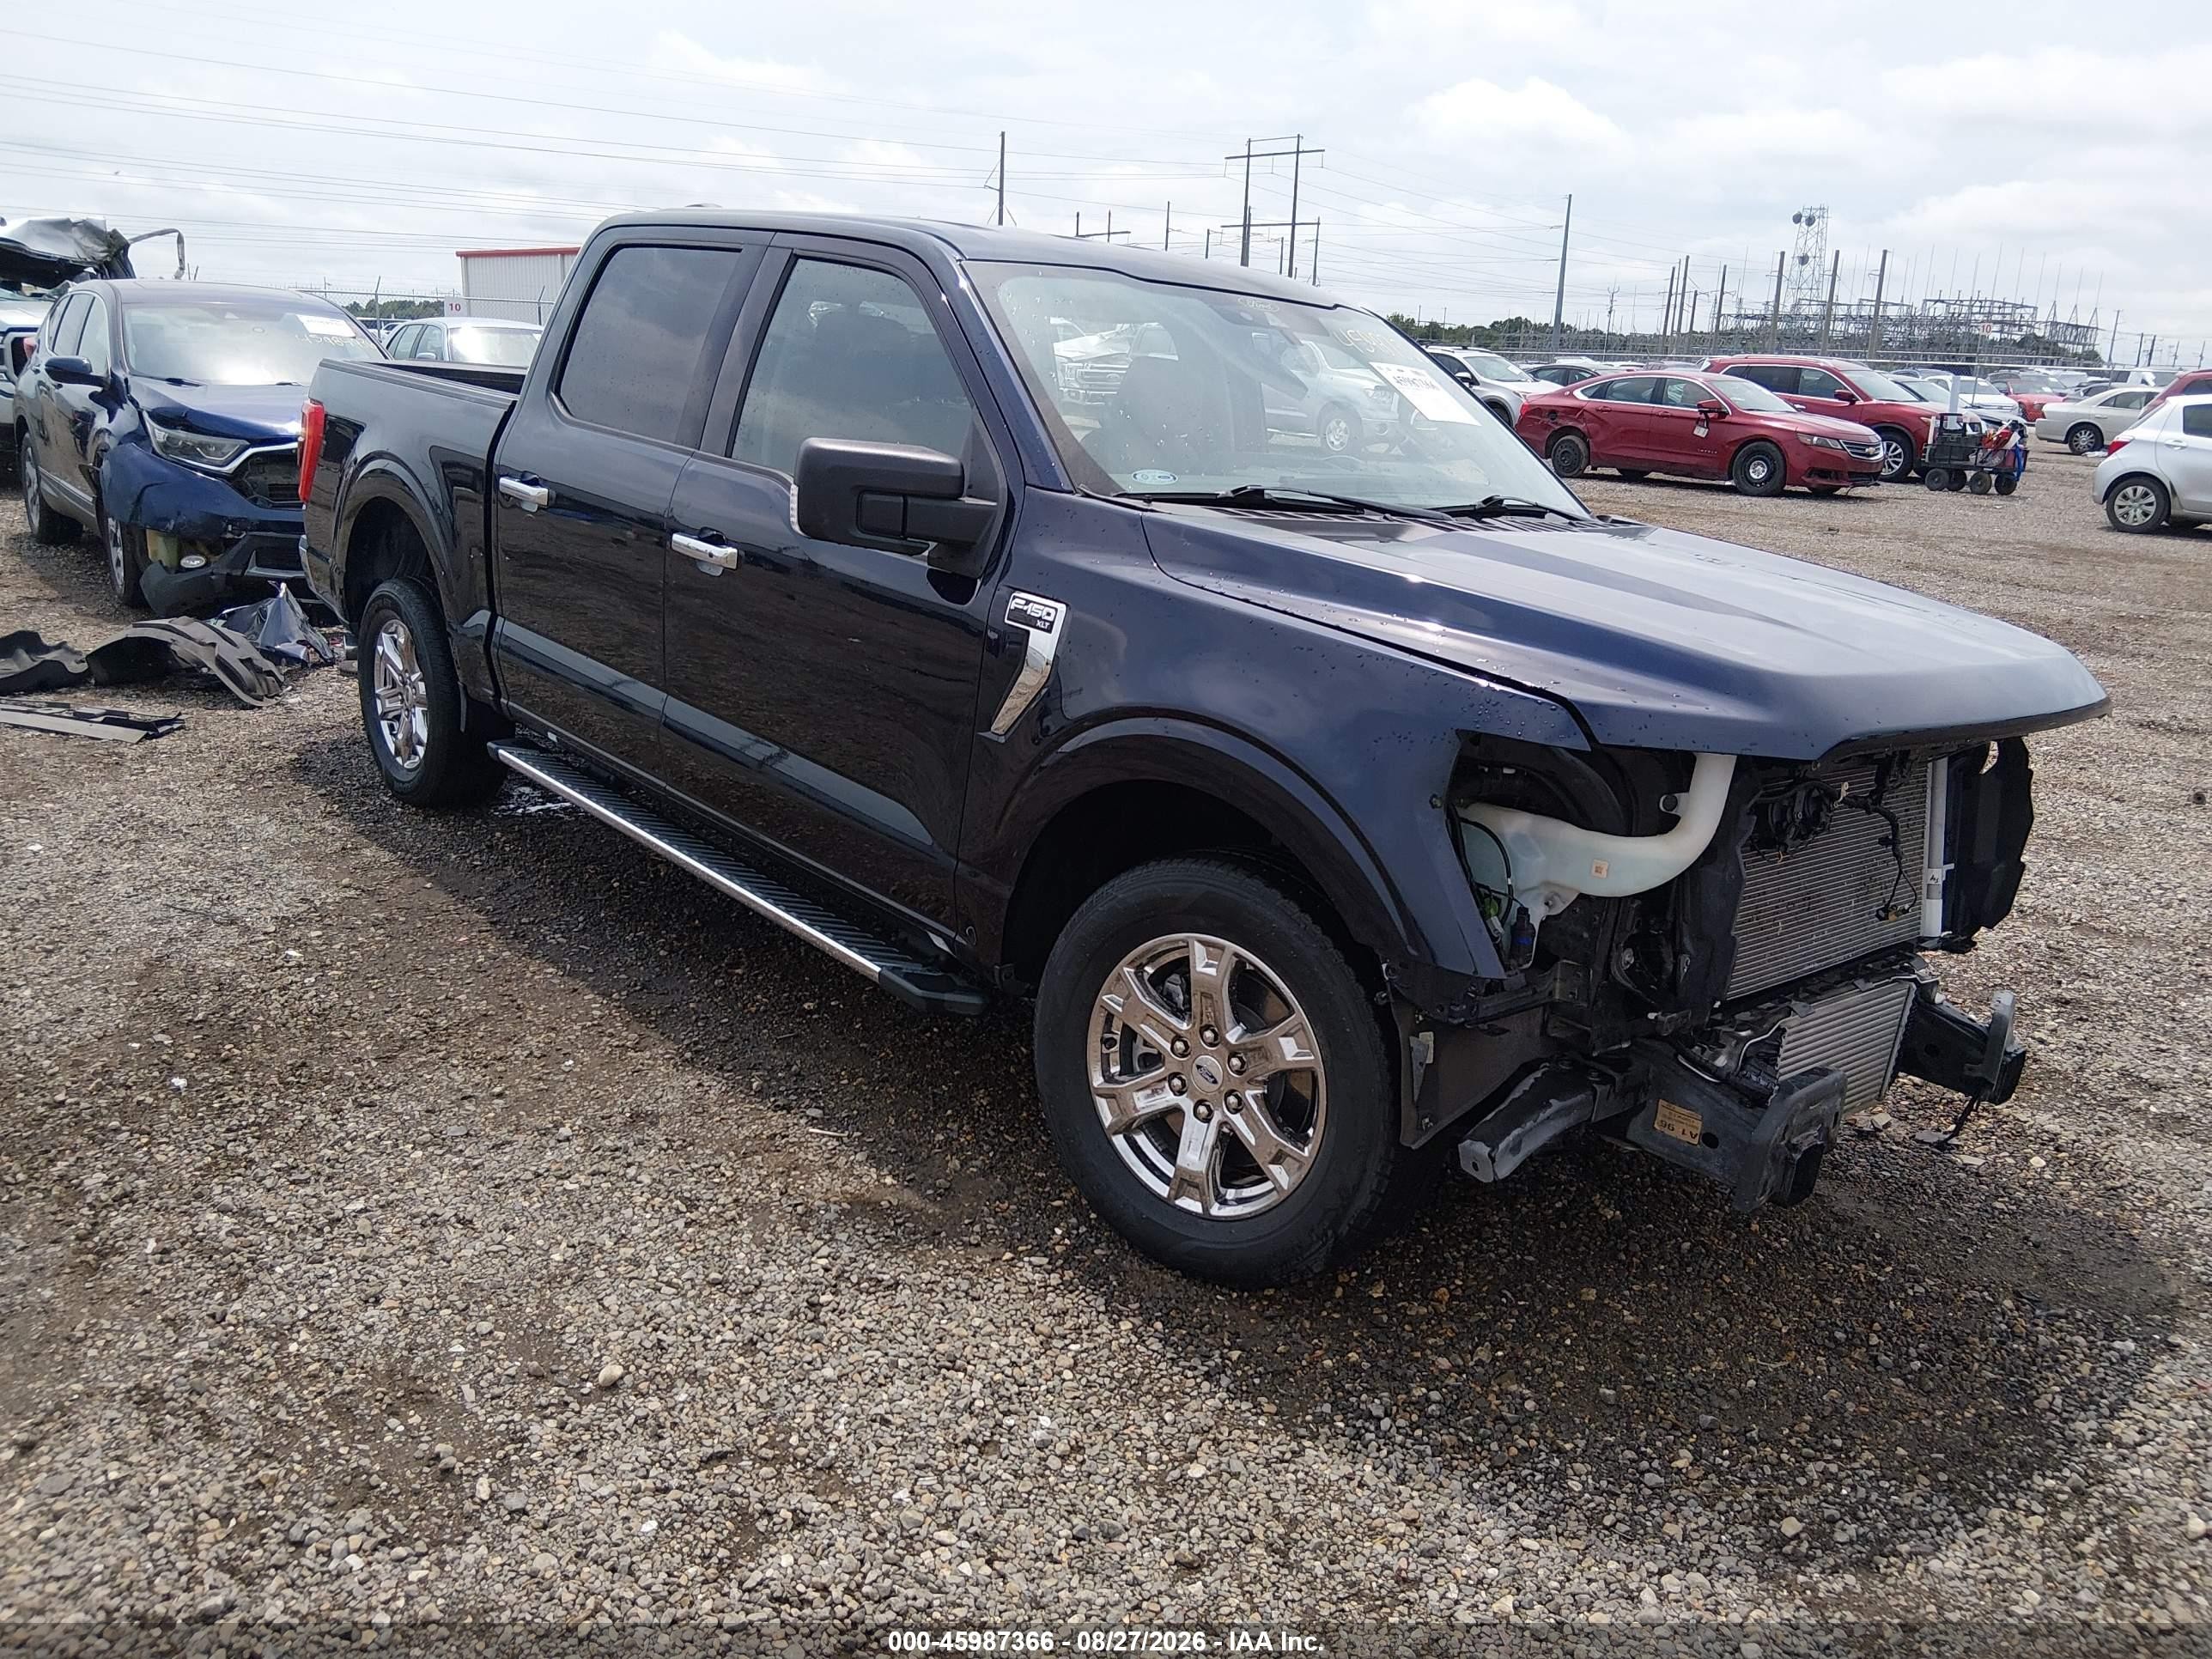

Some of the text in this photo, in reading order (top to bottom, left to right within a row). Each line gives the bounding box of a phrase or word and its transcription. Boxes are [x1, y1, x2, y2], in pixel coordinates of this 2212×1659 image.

[448, 302, 461, 312] 10
[1982, 324, 1991, 333] 10
[1036, 619, 1050, 629] XLT
